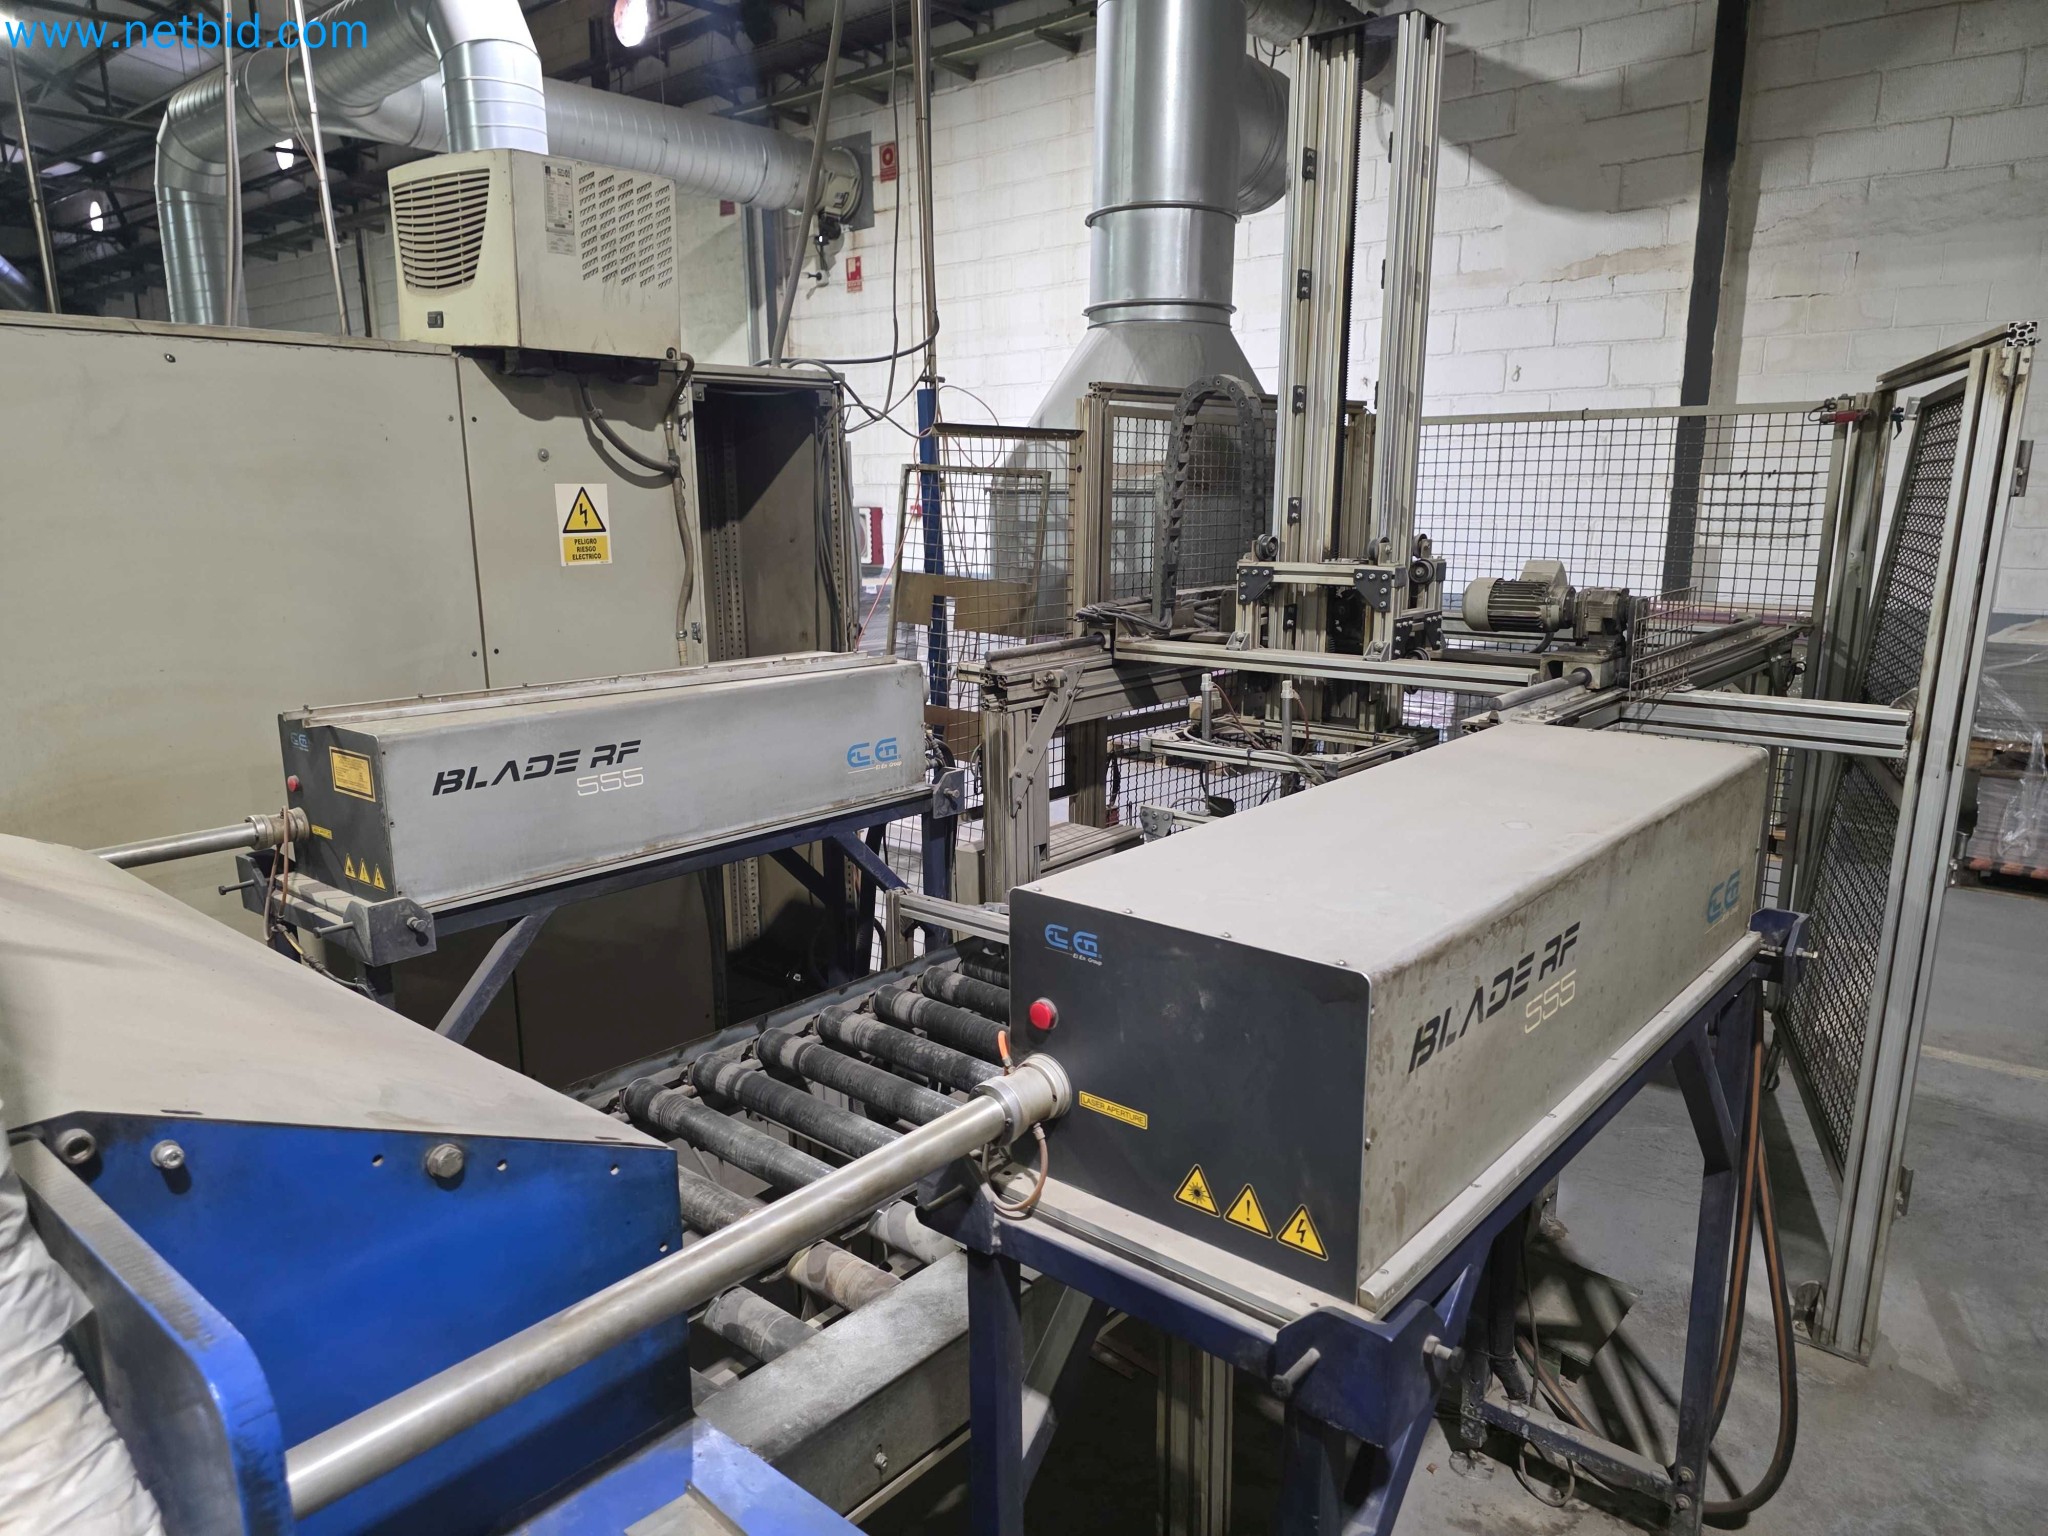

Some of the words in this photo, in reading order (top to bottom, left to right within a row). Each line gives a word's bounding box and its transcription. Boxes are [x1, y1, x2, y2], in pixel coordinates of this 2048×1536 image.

[572, 553, 602, 561] ELECTRICO
[574, 538, 598, 546] PELIGRO
[432, 749, 581, 796] BLADE
[590, 739, 642, 769] RF
[576, 766, 644, 797] 555
[1408, 951, 1536, 1074] BLADE
[1538, 921, 1581, 982] RF
[1524, 968, 1577, 1034] 555
[1082, 1096, 1106, 1109] LASER
[1106, 1105, 1144, 1125] APERTURE
